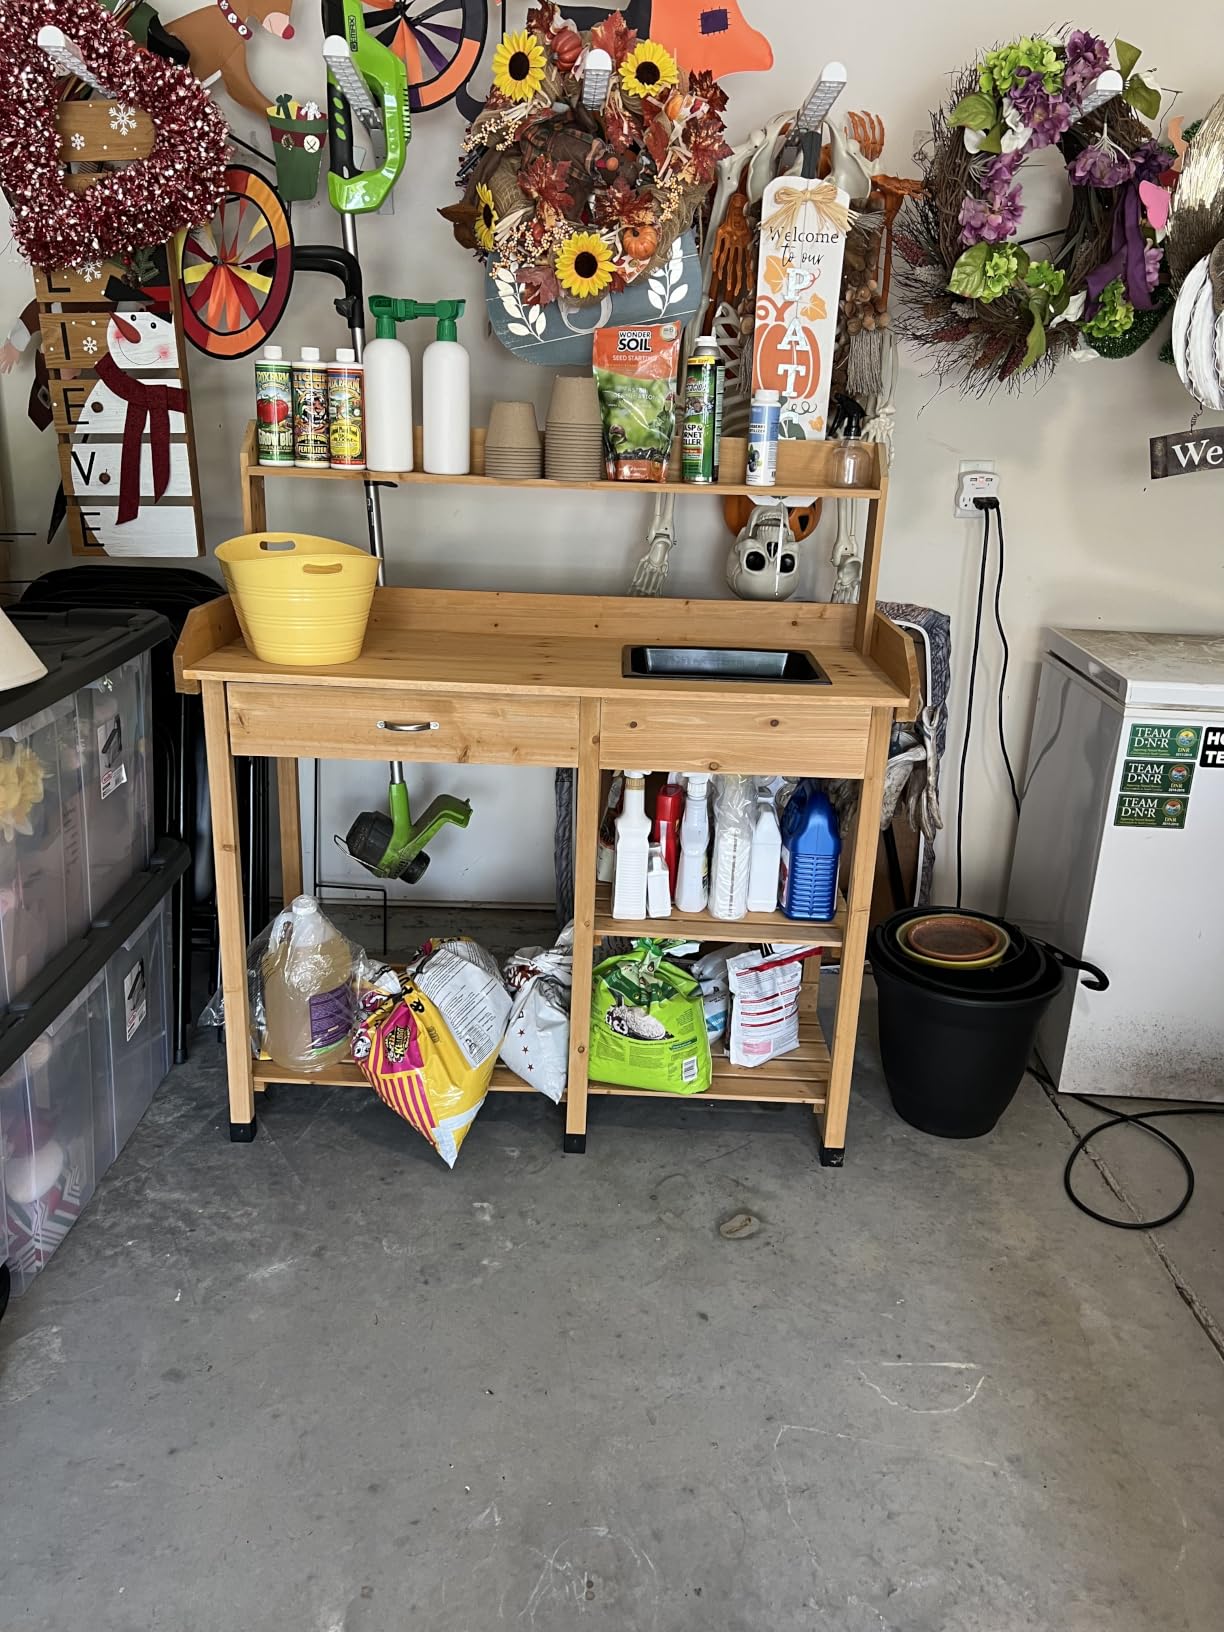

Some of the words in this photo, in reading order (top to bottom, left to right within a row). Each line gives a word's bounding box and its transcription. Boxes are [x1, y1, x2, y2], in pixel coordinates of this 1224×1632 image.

[770, 226, 839, 244] Welcome
[781, 243, 796, 267] to
[801, 253, 825, 266] our
[618, 338, 652, 351] SOIL
[1171, 439, 1223, 468] We
[1136, 727, 1172, 738] TEAM
[1129, 763, 1164, 774] TEAM
[1122, 797, 1158, 808] TEAM
